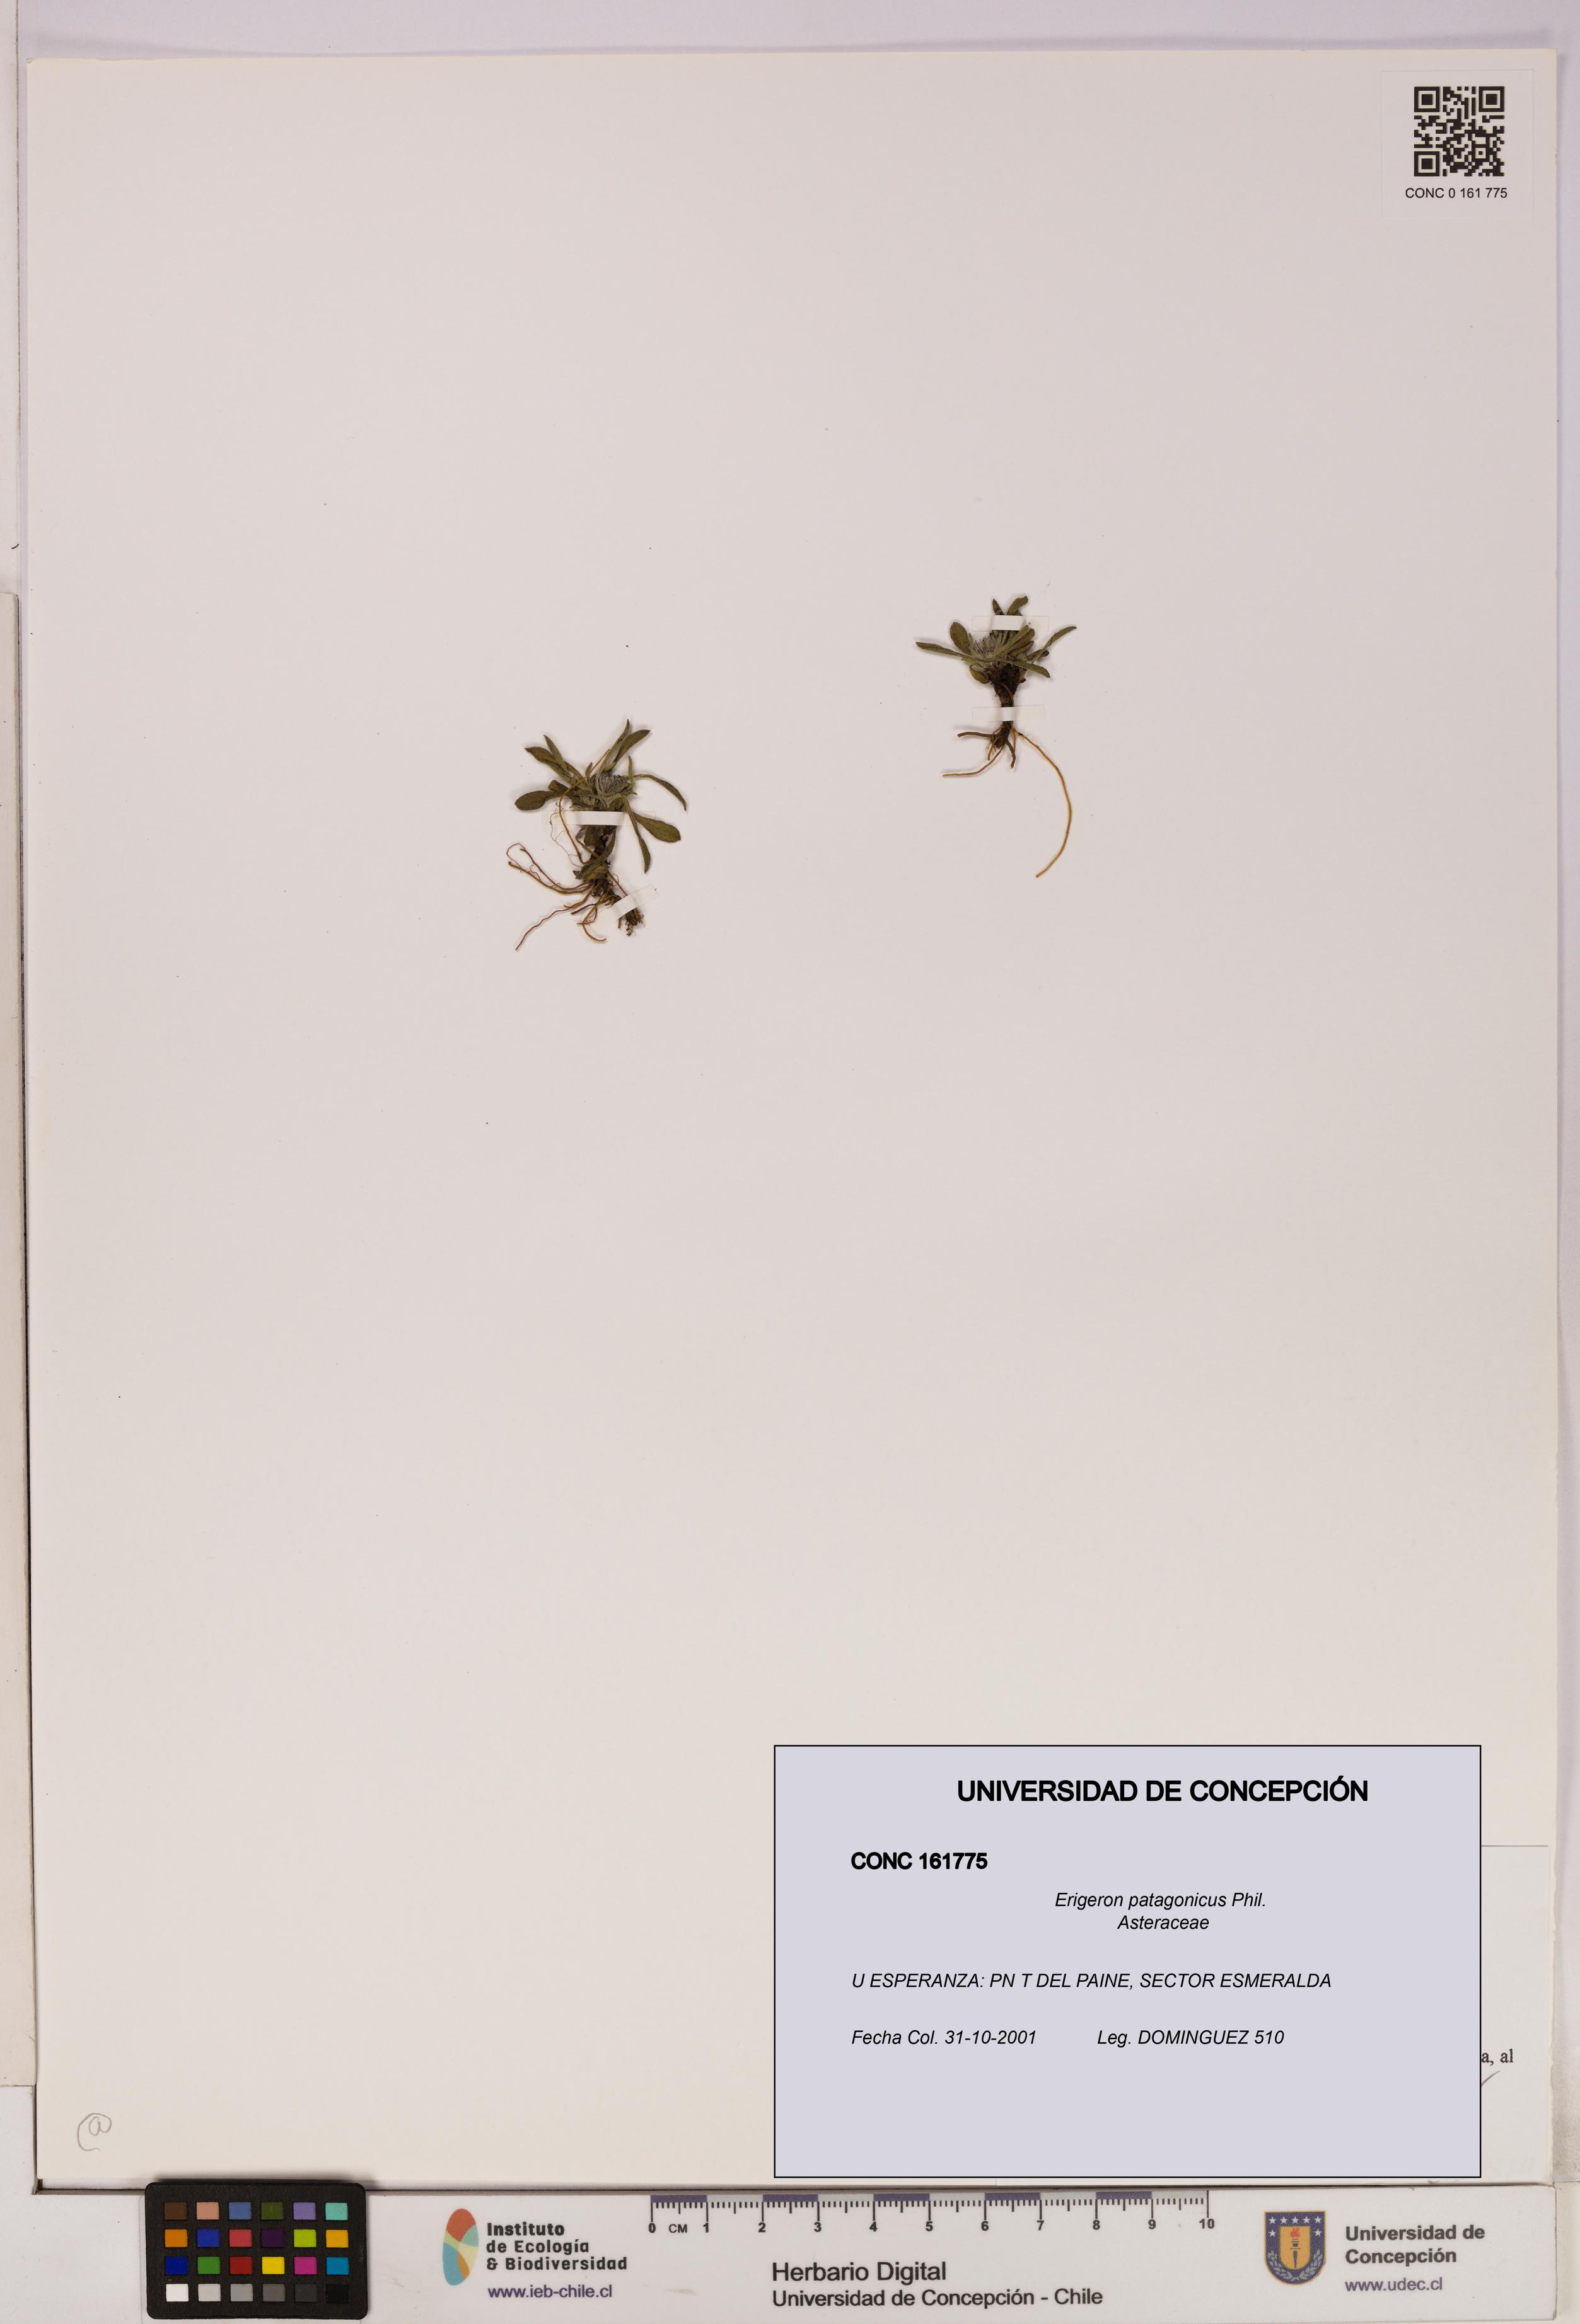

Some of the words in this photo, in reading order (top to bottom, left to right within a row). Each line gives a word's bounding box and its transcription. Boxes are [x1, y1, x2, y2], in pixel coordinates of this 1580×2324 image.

[1405, 187, 1444, 199] CONC
[1448, 187, 1456, 199] 0
[1460, 187, 1480, 199] 161
[1485, 187, 1507, 199] 775
[1500, 2048, 1514, 2064] al
[487, 2221, 565, 2236] Instituto
[648, 2222, 656, 2233] 0
[668, 2224, 688, 2233] CM
[703, 2222, 709, 2233] 1
[758, 2221, 766, 2233] 2
[814, 2221, 822, 2233] 3
[869, 2221, 878, 2232] 4
[925, 2221, 934, 2232] 5
[981, 2220, 989, 2231] 6
[1037, 2220, 1045, 2231] 7
[1092, 2219, 1101, 2230] 8
[1148, 2219, 1156, 2229] 9
[1199, 2218, 1215, 2229] 10
[1345, 2224, 1457, 2241] Universidad
[1462, 2224, 1485, 2240] de
[485, 2240, 507, 2253] de
[514, 2239, 589, 2254] Ecología
[486, 2257, 498, 2270] &
[505, 2256, 627, 2270] Biodiversidad
[1345, 2247, 1457, 2267] Concepción
[772, 2262, 869, 2282] Herbario
[877, 2261, 946, 2286] Digital
[487, 2284, 612, 2298] www.ieb-chile.cl
[1344, 2276, 1443, 2292] www.udec.cl
[772, 2289, 885, 2307] Universidad
[891, 2289, 915, 2306] de
[921, 2288, 1035, 2310] Concepción
[1054, 2288, 1103, 2305] Chile
